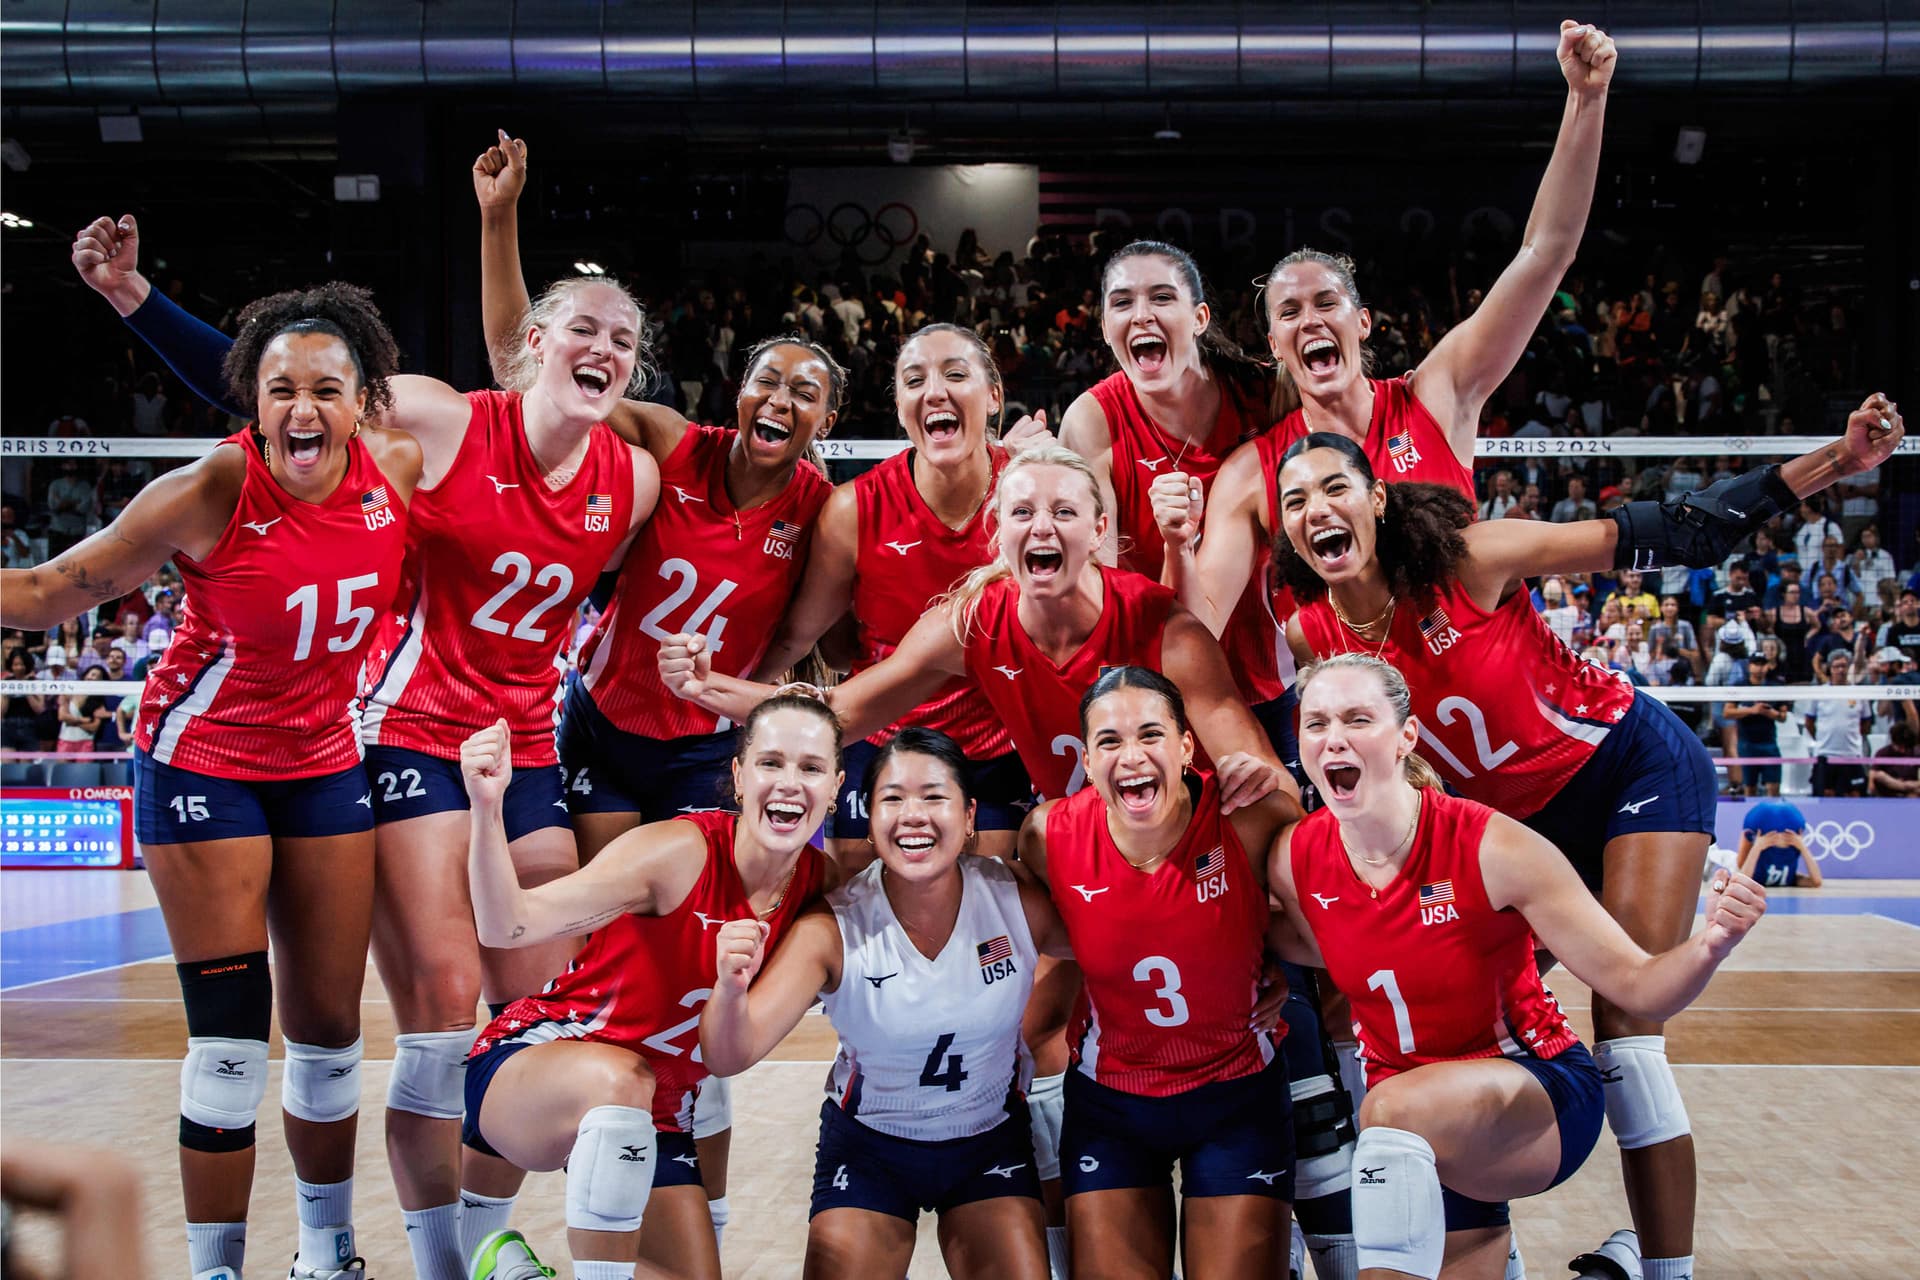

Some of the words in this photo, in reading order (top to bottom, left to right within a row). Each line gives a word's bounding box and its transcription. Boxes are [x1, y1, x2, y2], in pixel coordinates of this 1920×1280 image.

[2, 440, 48, 454] ARIS
[56, 440, 110, 454] 2024
[815, 443, 853, 456] 024
[1392, 445, 1422, 473] USA
[1486, 440, 1546, 453] PARIS
[1556, 440, 1611, 453] 2024
[364, 506, 396, 531] USA
[584, 515, 610, 532] USA
[763, 538, 793, 560] USA
[470, 551, 574, 643] 22
[638, 557, 739, 657] 24
[286, 572, 379, 661] 15
[1427, 626, 1463, 656] USA
[1417, 696, 1521, 779] 12
[1051, 734, 1087, 797] 2
[84, 788, 132, 800] OMEGA
[377, 768, 427, 802] 22
[169, 795, 210, 823] 15
[1196, 872, 1229, 903] USA
[1420, 904, 1460, 926] USA
[981, 959, 1017, 985] USA
[1132, 955, 1190, 1027] 3
[641, 987, 714, 1063] 2
[1366, 969, 1416, 1055] 1
[919, 1032, 969, 1092] 4
[832, 1164, 849, 1191] 4
